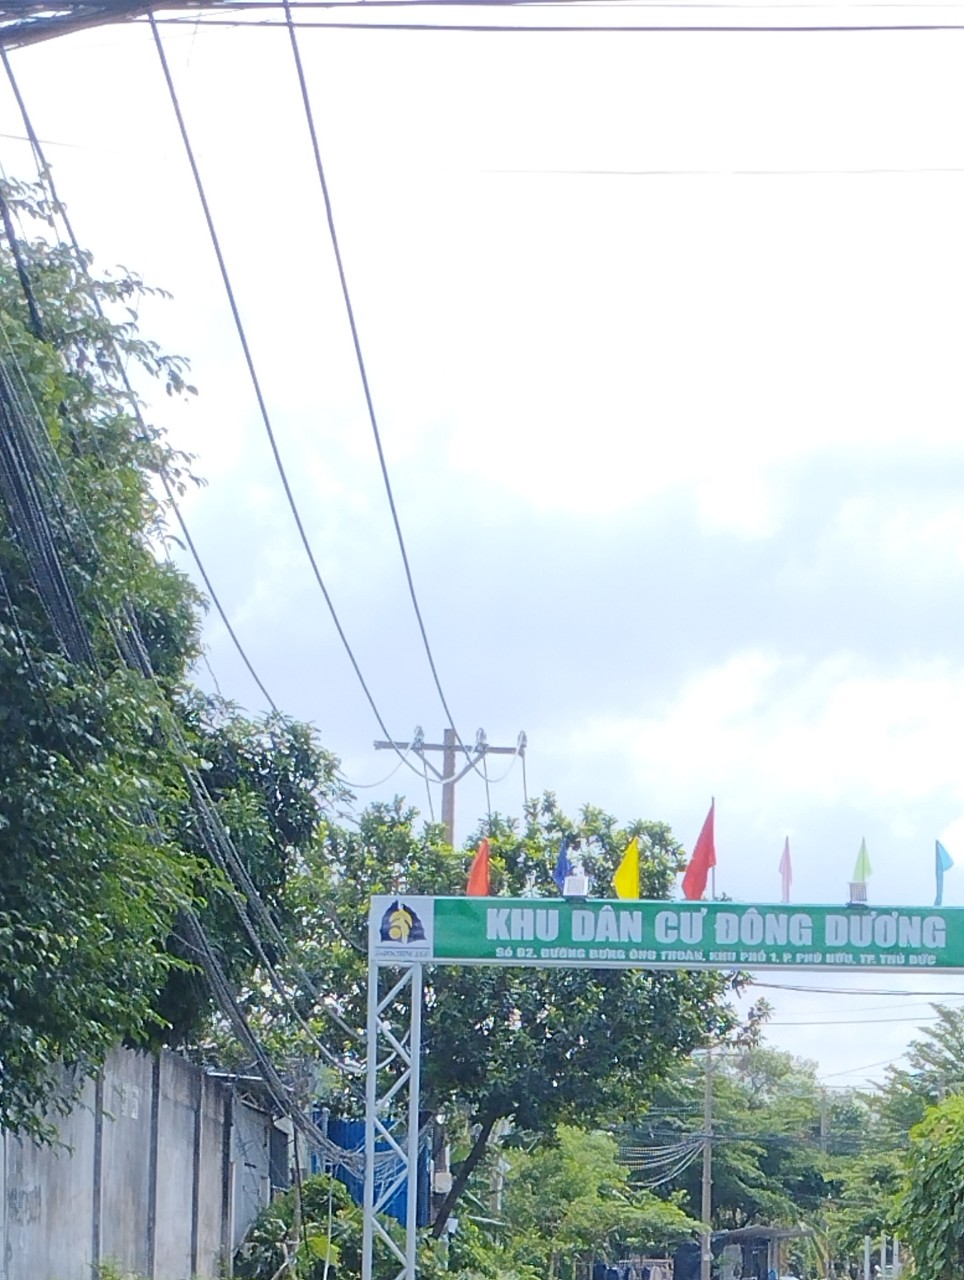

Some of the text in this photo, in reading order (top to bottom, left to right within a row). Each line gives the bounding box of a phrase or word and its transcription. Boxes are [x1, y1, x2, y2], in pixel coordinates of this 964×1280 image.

[487, 905, 946, 948] KHU DÂN CƯ ĐÔNG DƯƠNG
[709, 951, 736, 961] KHU
[740, 949, 766, 961] PHỐ
[909, 953, 937, 965] ĐỨC
